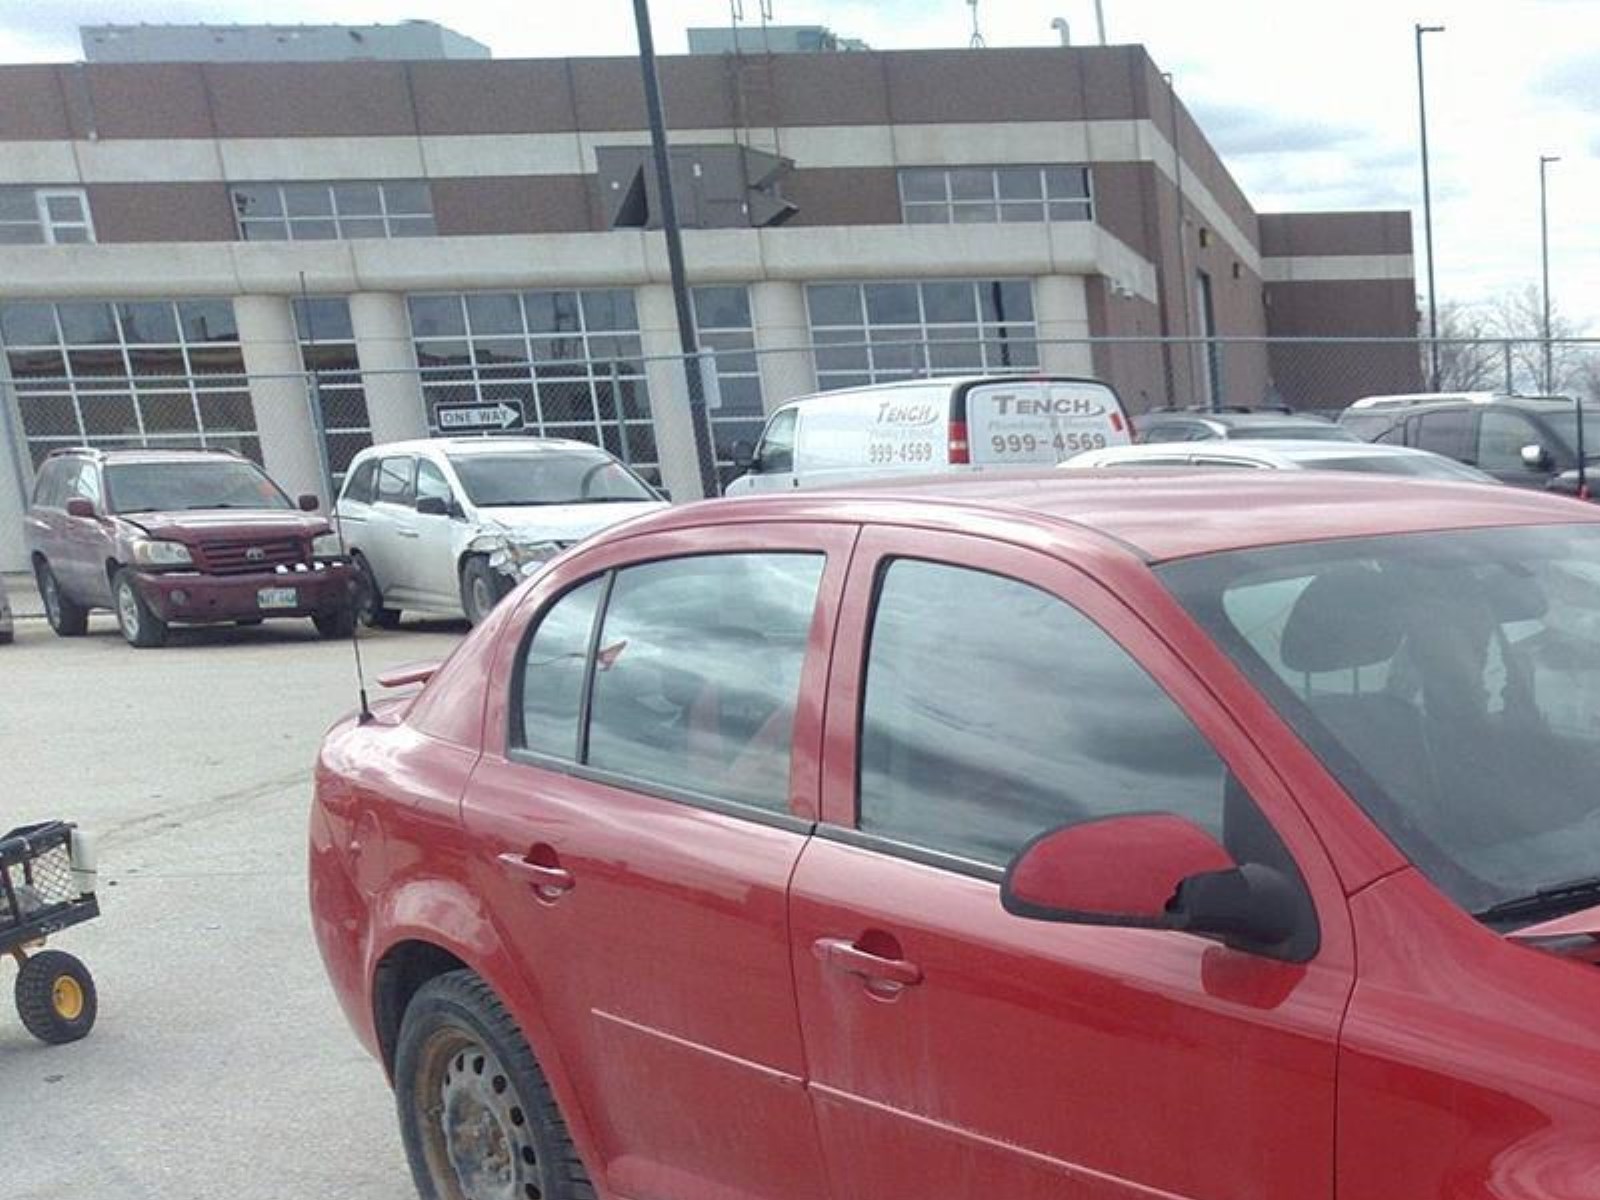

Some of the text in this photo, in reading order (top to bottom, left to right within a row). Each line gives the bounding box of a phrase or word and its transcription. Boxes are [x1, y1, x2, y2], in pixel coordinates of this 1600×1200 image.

[991, 395, 1090, 415] TENCH
[443, 408, 509, 424] ONE WAY
[869, 442, 932, 463] 999-4569
[991, 432, 1106, 453] 999-4569
